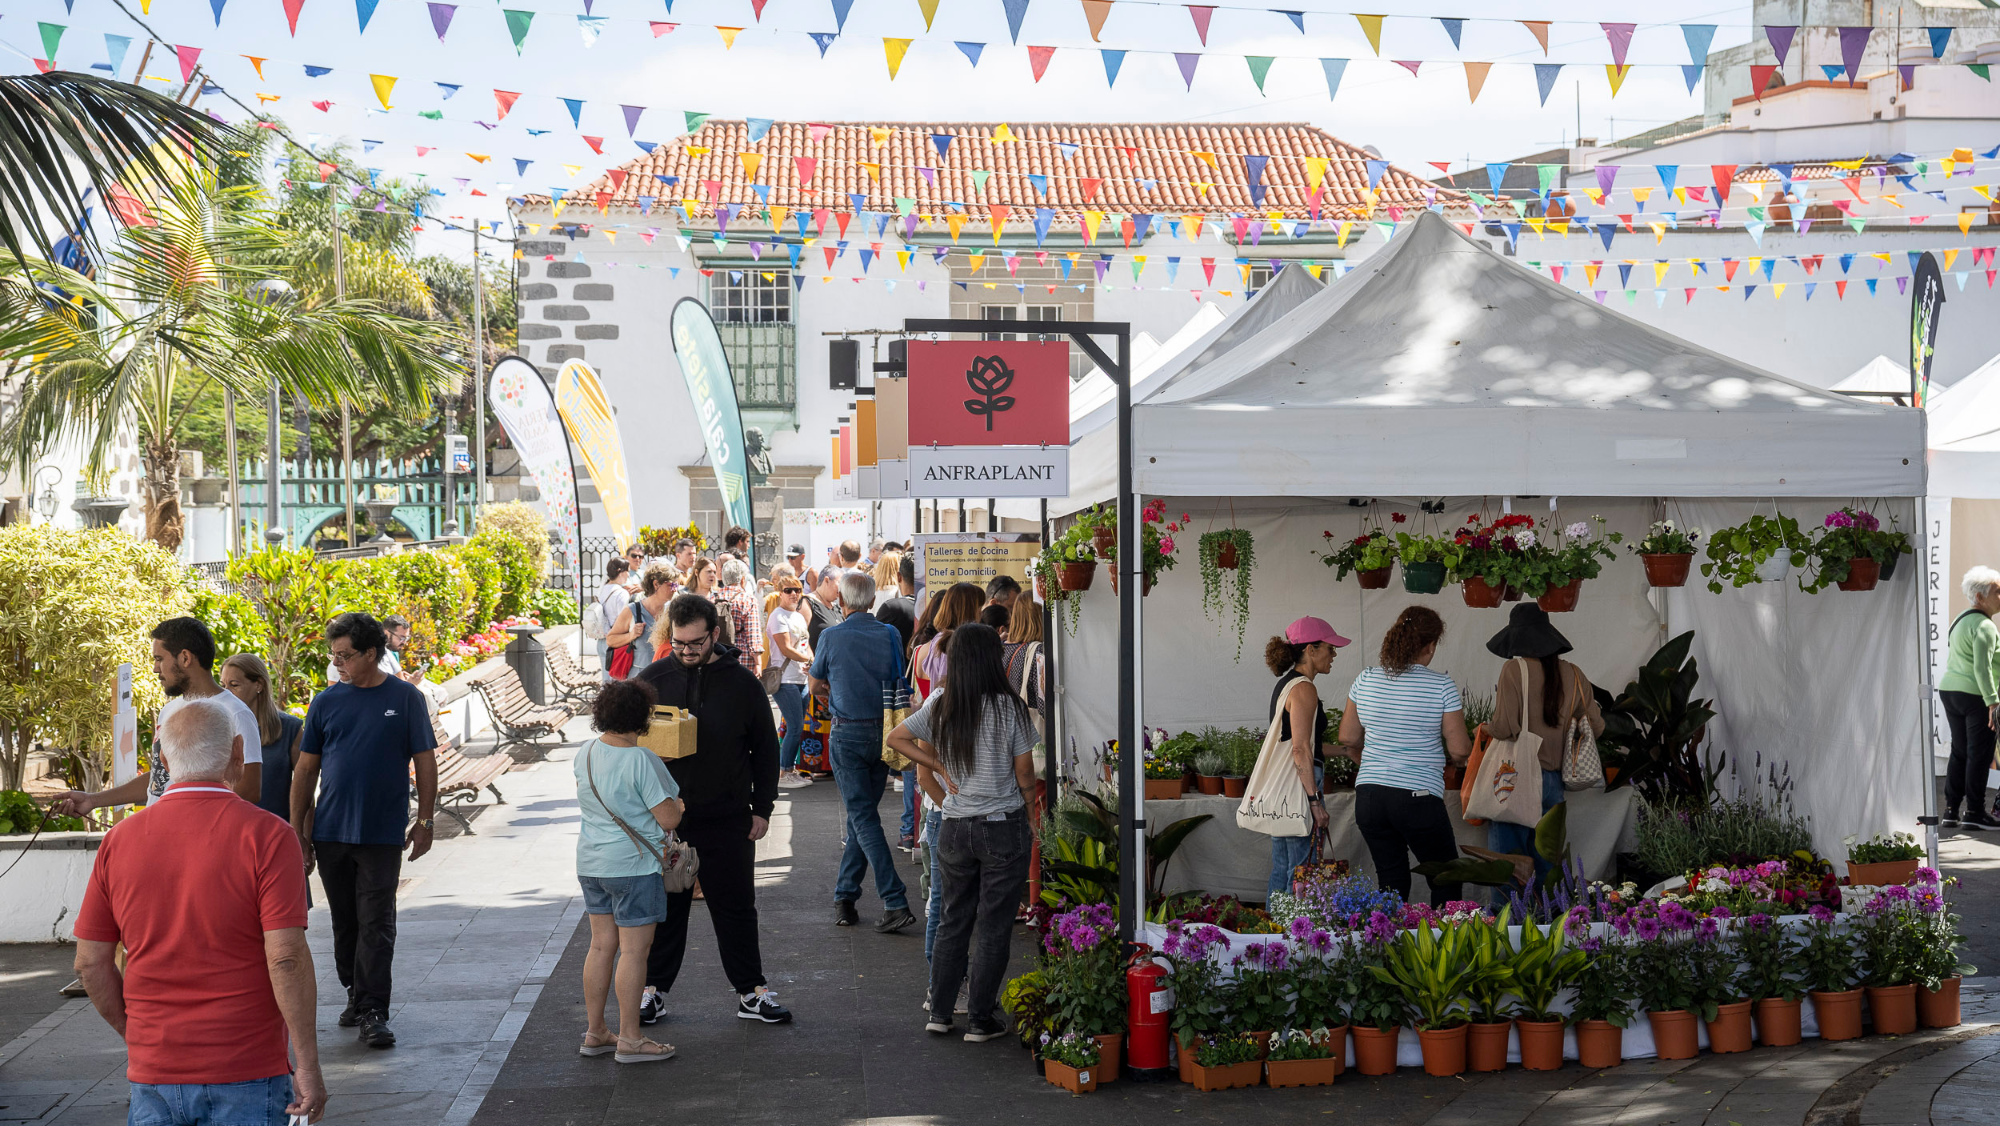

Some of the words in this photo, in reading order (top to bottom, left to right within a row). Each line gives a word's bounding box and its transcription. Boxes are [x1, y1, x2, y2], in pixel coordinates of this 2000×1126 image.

[923, 465, 1055, 481] ANFRAPLANT
[929, 547, 963, 556] Talleres
[968, 547, 978, 555] de
[980, 547, 1009, 555] Cocina
[928, 567, 949, 576] Chef
[957, 567, 997, 576] Domicilio
